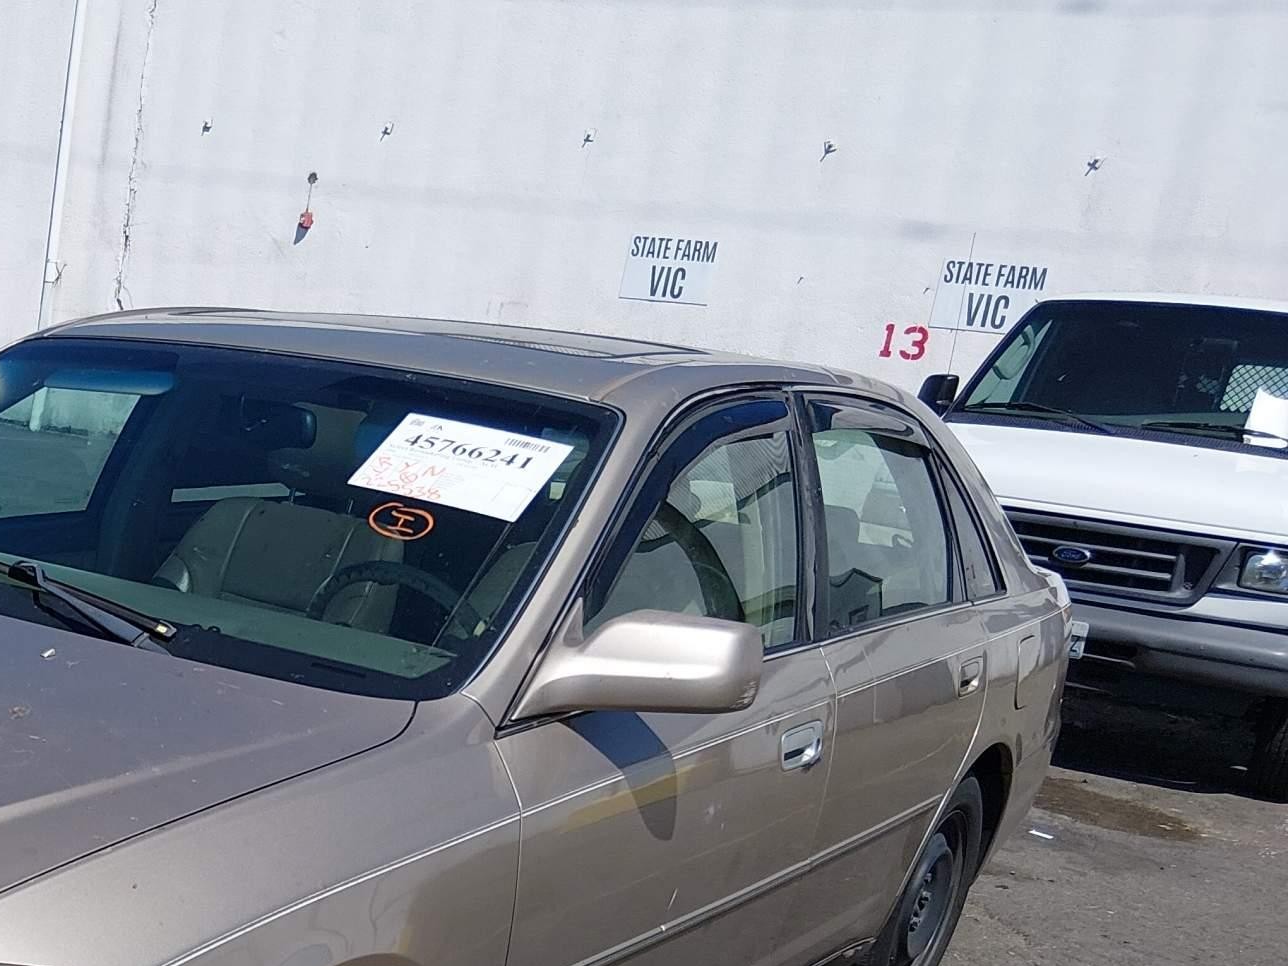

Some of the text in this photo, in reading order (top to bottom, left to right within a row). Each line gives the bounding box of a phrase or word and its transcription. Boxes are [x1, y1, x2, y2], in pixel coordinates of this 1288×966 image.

[631, 236, 719, 263] STATE FARM
[649, 265, 687, 299] VIC
[944, 260, 1048, 291] STATE FARM
[966, 293, 1010, 330] VIC
[879, 323, 929, 360] 13
[405, 434, 533, 469] 45766241
